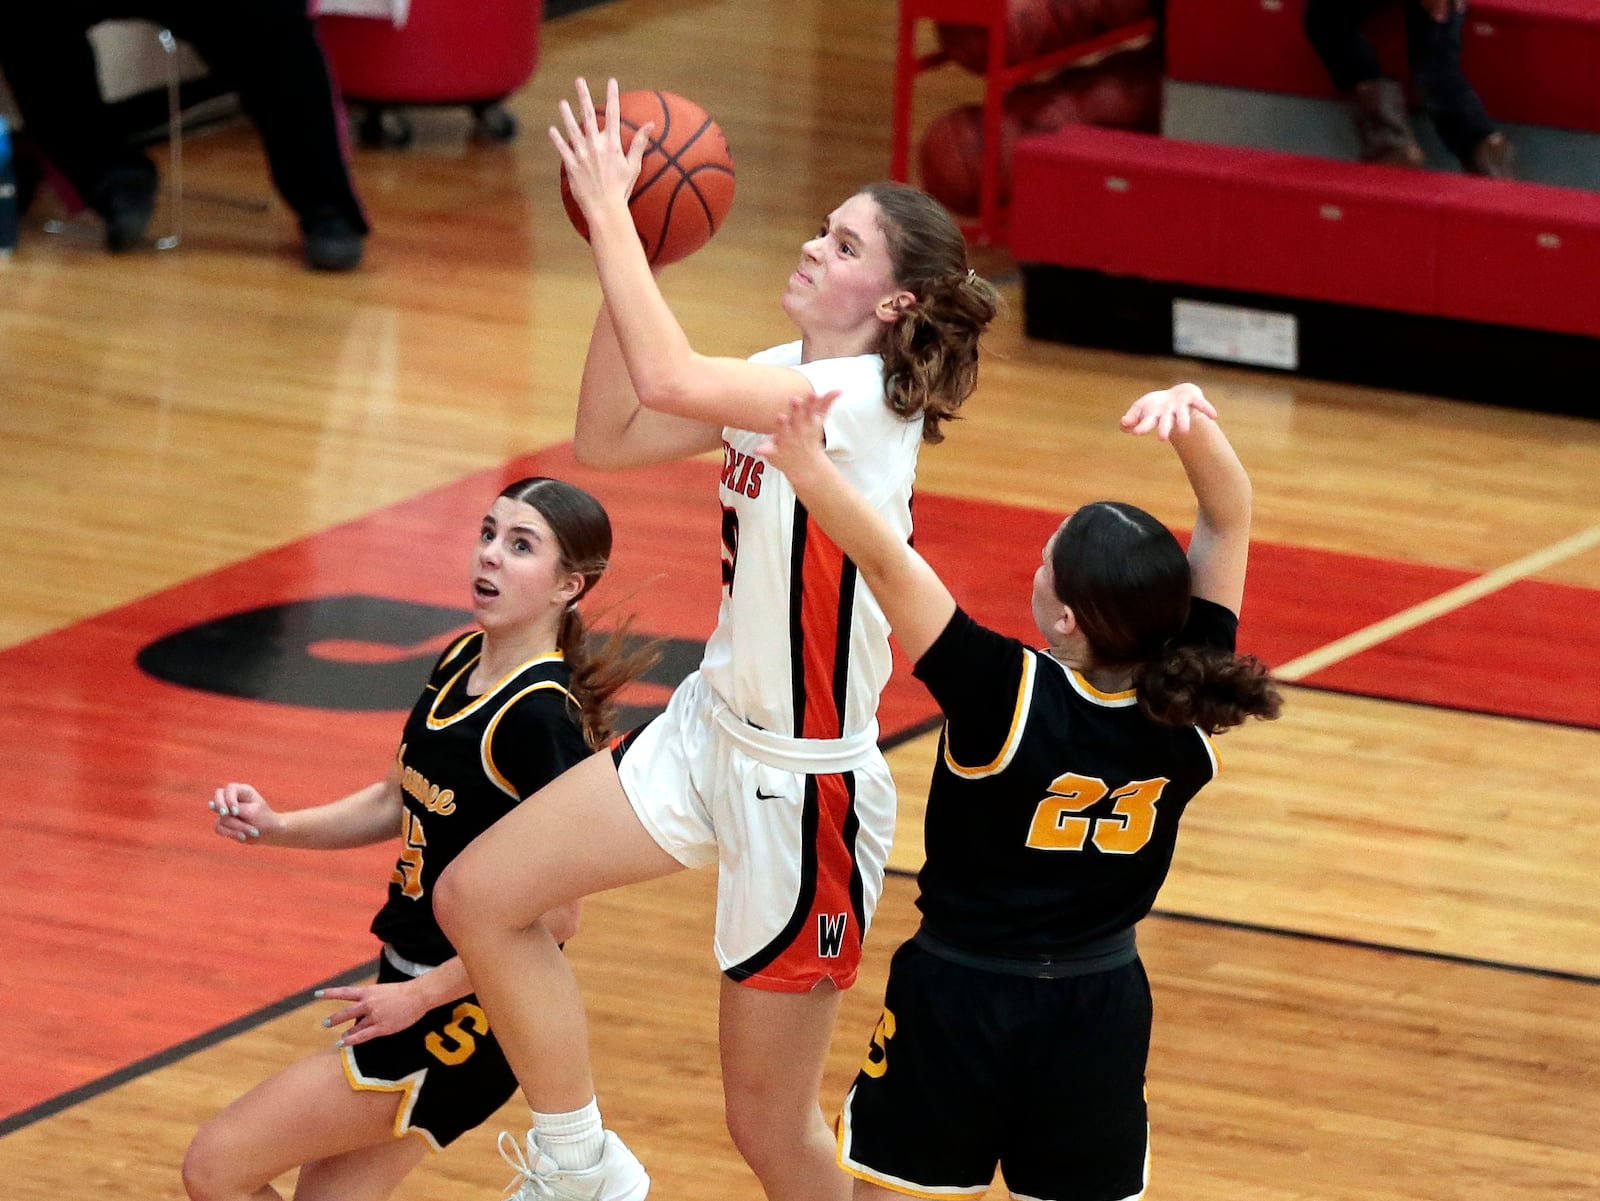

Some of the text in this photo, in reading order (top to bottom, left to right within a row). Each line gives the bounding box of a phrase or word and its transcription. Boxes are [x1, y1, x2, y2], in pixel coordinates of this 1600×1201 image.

[1024, 771, 1171, 855] 23
[817, 911, 848, 958] W
[424, 1001, 490, 1066] S
